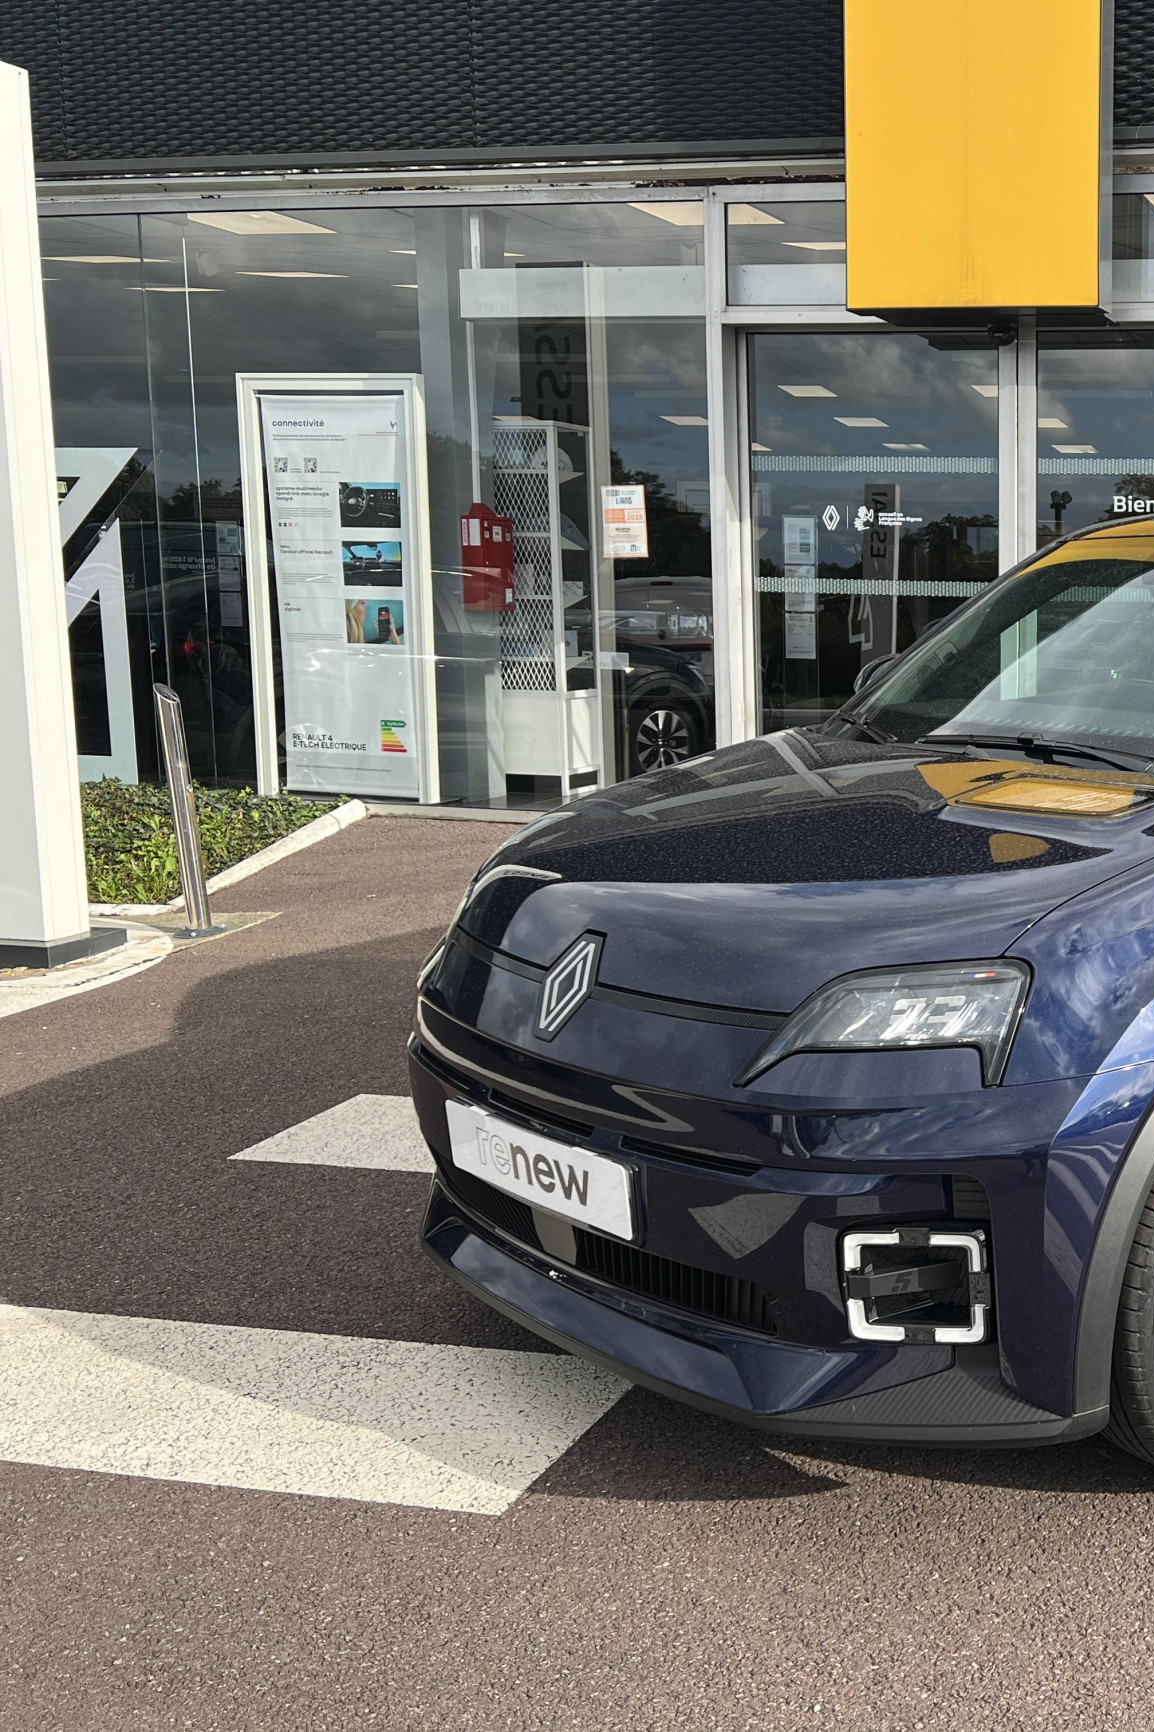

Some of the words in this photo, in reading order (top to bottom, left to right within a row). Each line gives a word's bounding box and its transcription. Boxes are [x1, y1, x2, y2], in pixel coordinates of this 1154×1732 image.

[272, 418, 324, 427] connectivité
[292, 733, 326, 742] RENAULT
[328, 734, 333, 742] 4
[476, 1126, 590, 1206] renew
